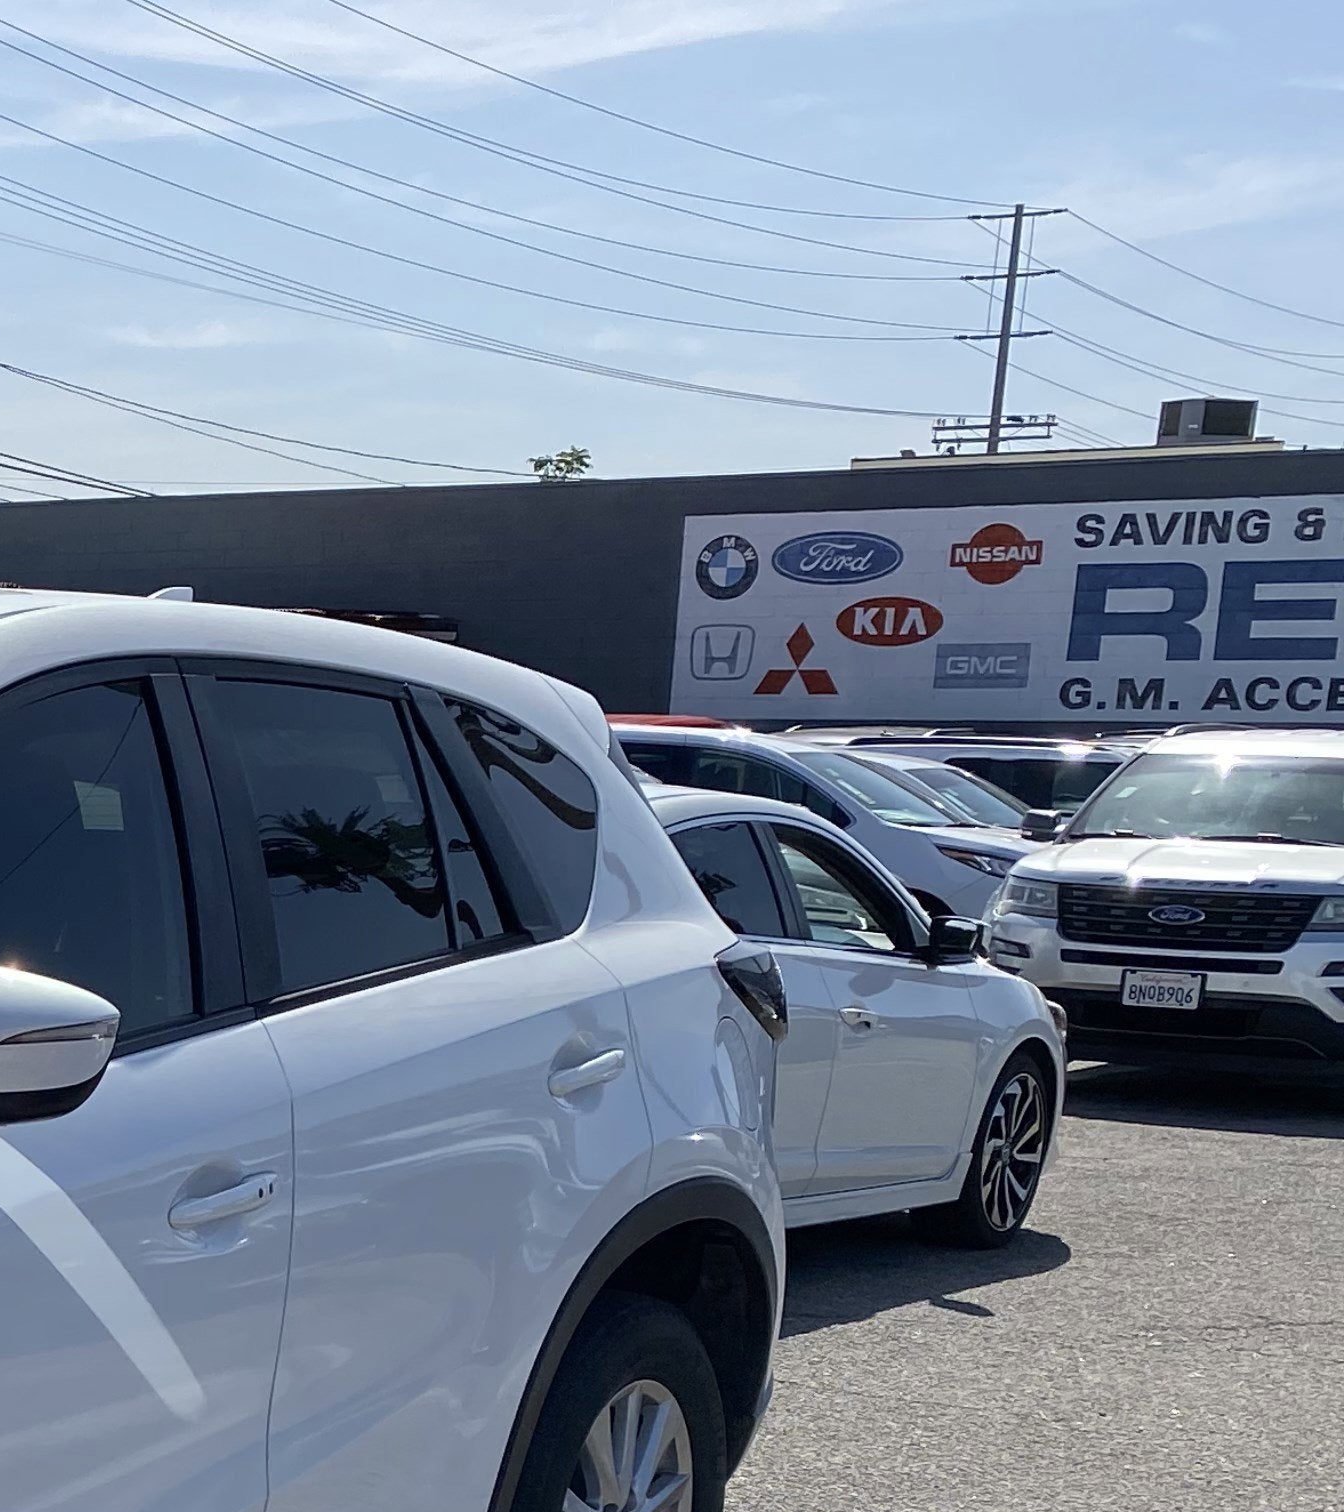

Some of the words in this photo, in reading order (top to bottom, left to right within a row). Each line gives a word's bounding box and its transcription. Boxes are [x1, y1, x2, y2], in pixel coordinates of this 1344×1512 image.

[1073, 508, 1271, 549] SAVING
[1293, 507, 1327, 542] &
[699, 536, 757, 563] BMW
[798, 541, 875, 573] Ford
[954, 544, 1038, 564] NISSAN
[852, 606, 928, 636] KIA
[1065, 558, 1344, 662] RE
[945, 655, 1019, 675] GMC
[1058, 676, 1180, 711] G.M.
